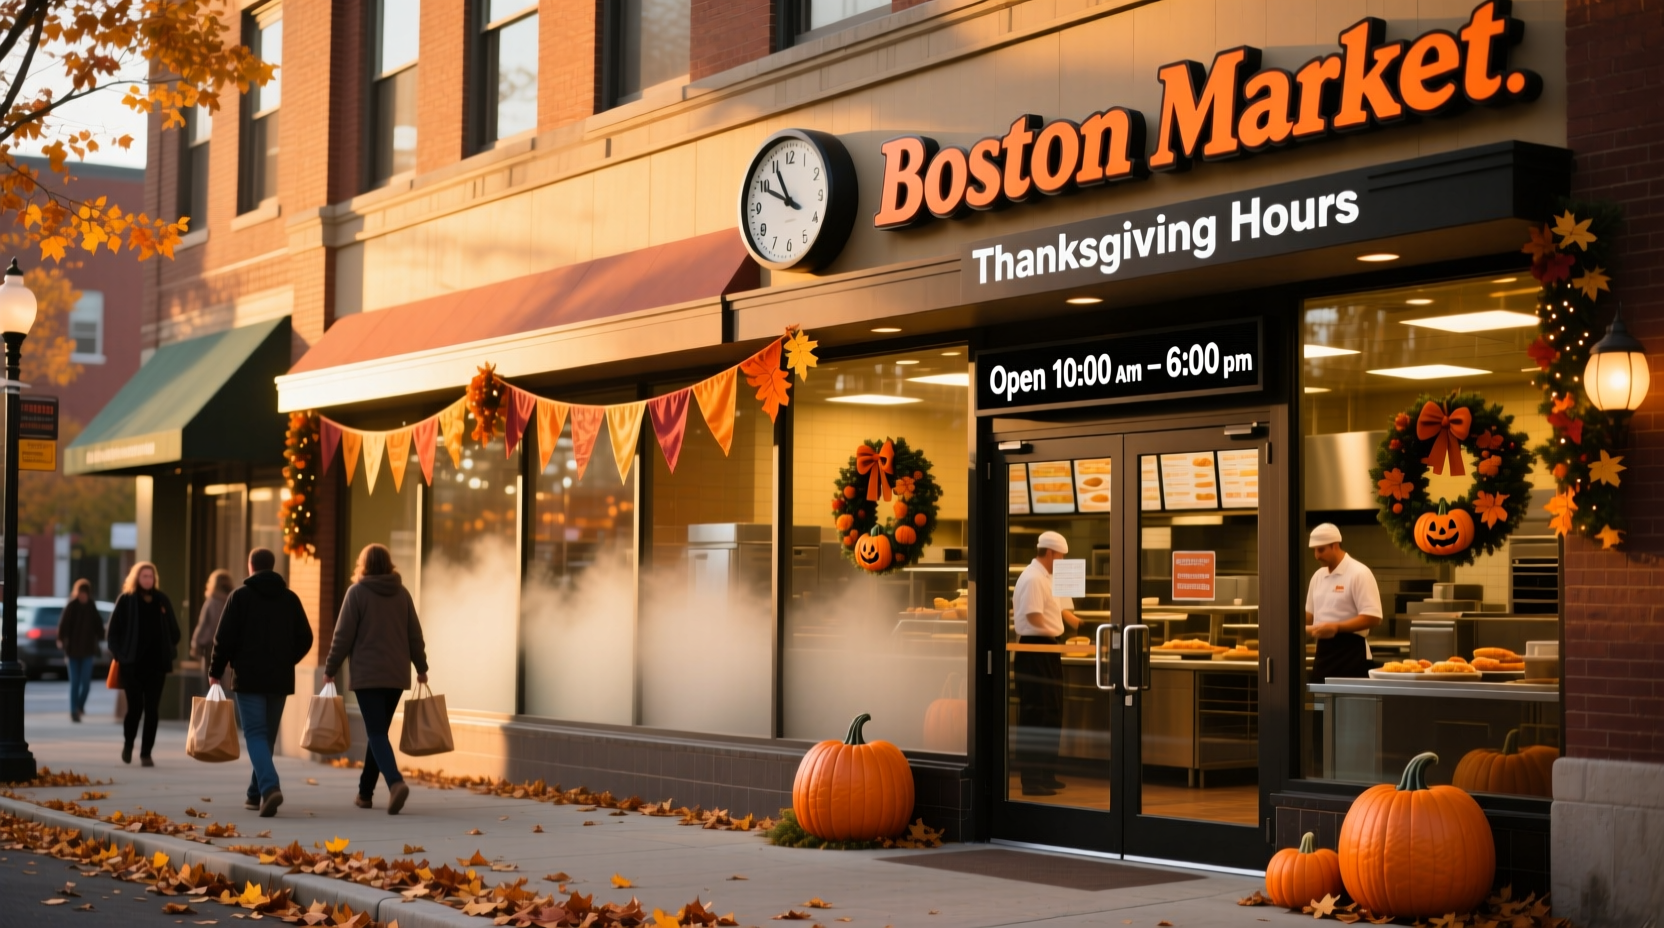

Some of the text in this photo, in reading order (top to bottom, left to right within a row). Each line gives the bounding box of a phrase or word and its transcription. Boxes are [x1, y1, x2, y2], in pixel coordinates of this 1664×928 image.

[785, 150, 795, 165] 12
[813, 167, 820, 181] 2
[874, 108, 1131, 228] Boston
[760, 179, 770, 193] 10
[756, 202, 762, 215] 9
[812, 211, 818, 224] 4
[772, 236, 778, 250] 7
[972, 190, 1361, 285] Thanksgiving Hours
[990, 365, 1046, 402] Open
[1052, 353, 1112, 389] 10:00
[1166, 341, 1220, 378] 6:00
[1223, 353, 1253, 379] pm
